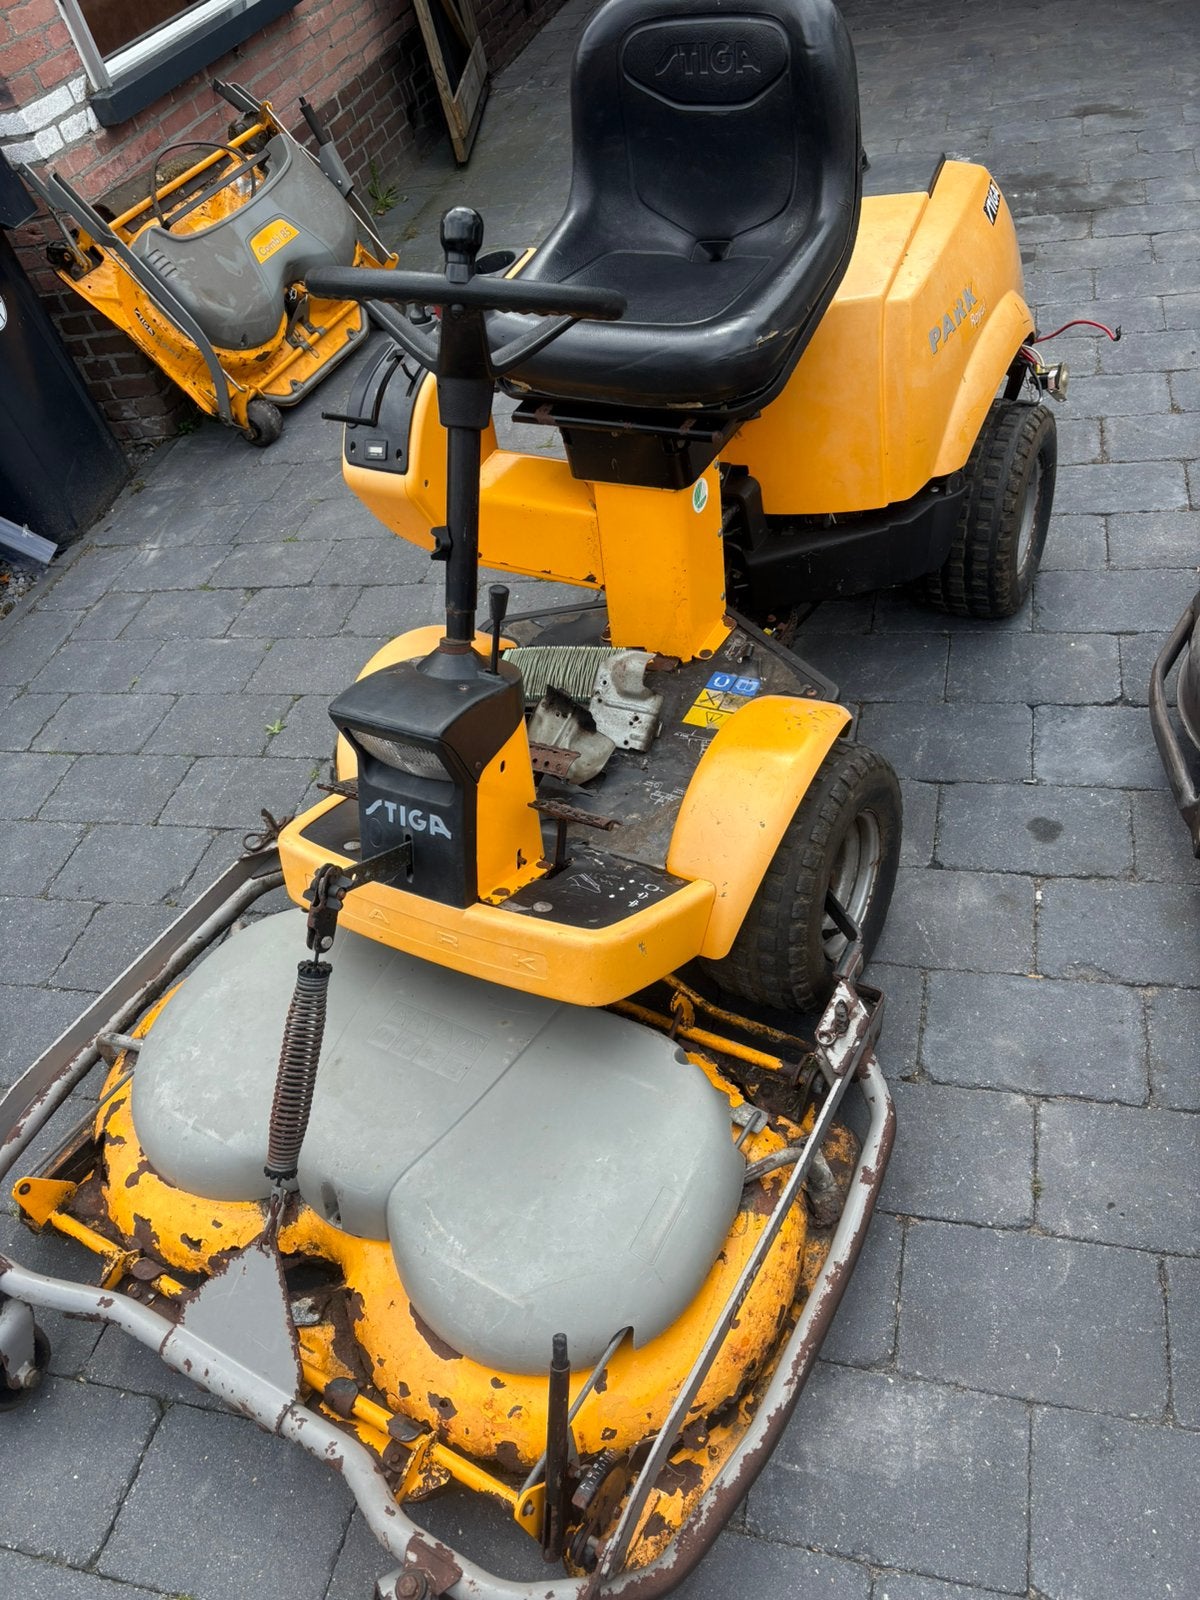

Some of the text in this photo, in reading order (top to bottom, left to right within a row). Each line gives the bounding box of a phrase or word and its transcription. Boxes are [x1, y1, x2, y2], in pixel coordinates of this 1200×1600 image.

[655, 41, 761, 76] STIGA
[258, 231, 282, 256] Combi
[928, 284, 976, 354] PARK
[365, 799, 452, 840] STIGA
[368, 908, 537, 971] ARK
